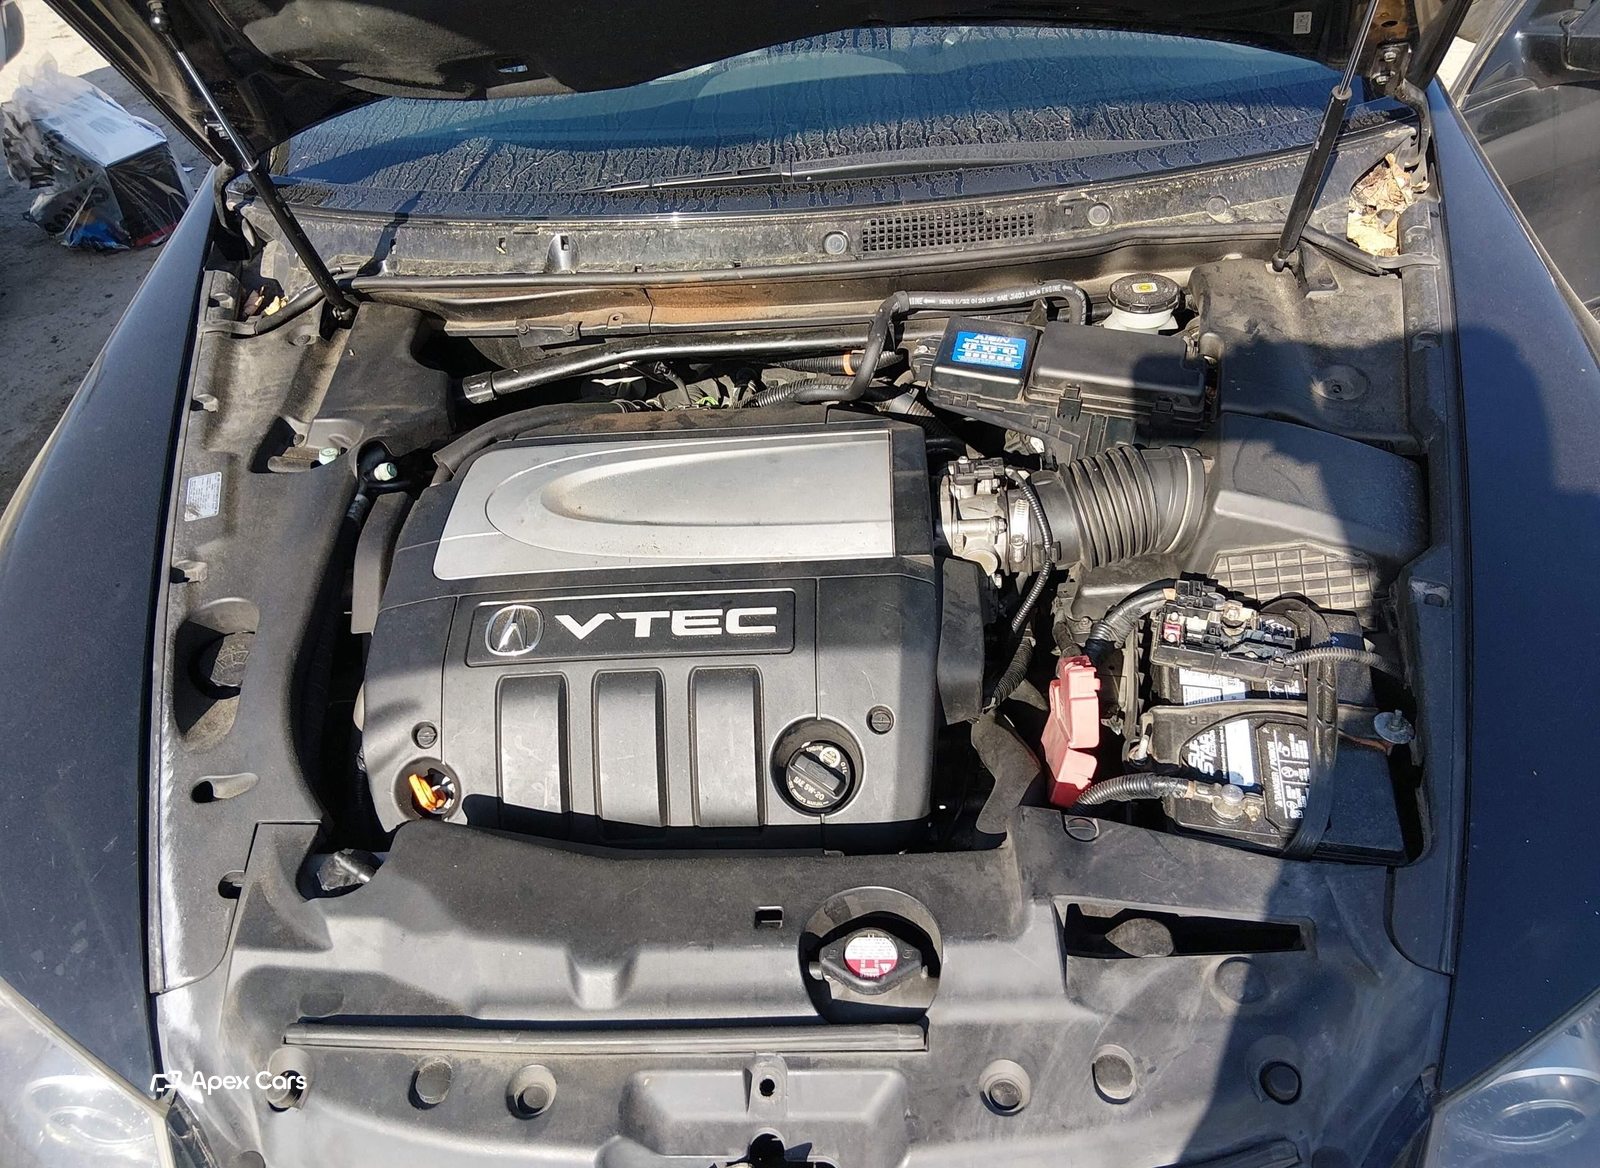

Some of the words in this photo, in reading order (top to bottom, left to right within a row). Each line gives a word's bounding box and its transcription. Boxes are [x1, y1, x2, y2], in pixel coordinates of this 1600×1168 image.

[554, 606, 778, 641] VTEC
[1267, 741, 1278, 766] POISON
[840, 761, 848, 774] OIL
[793, 776, 806, 788] SAE
[803, 783, 825, 800] 5W-20
[1271, 771, 1283, 800] DANGER
